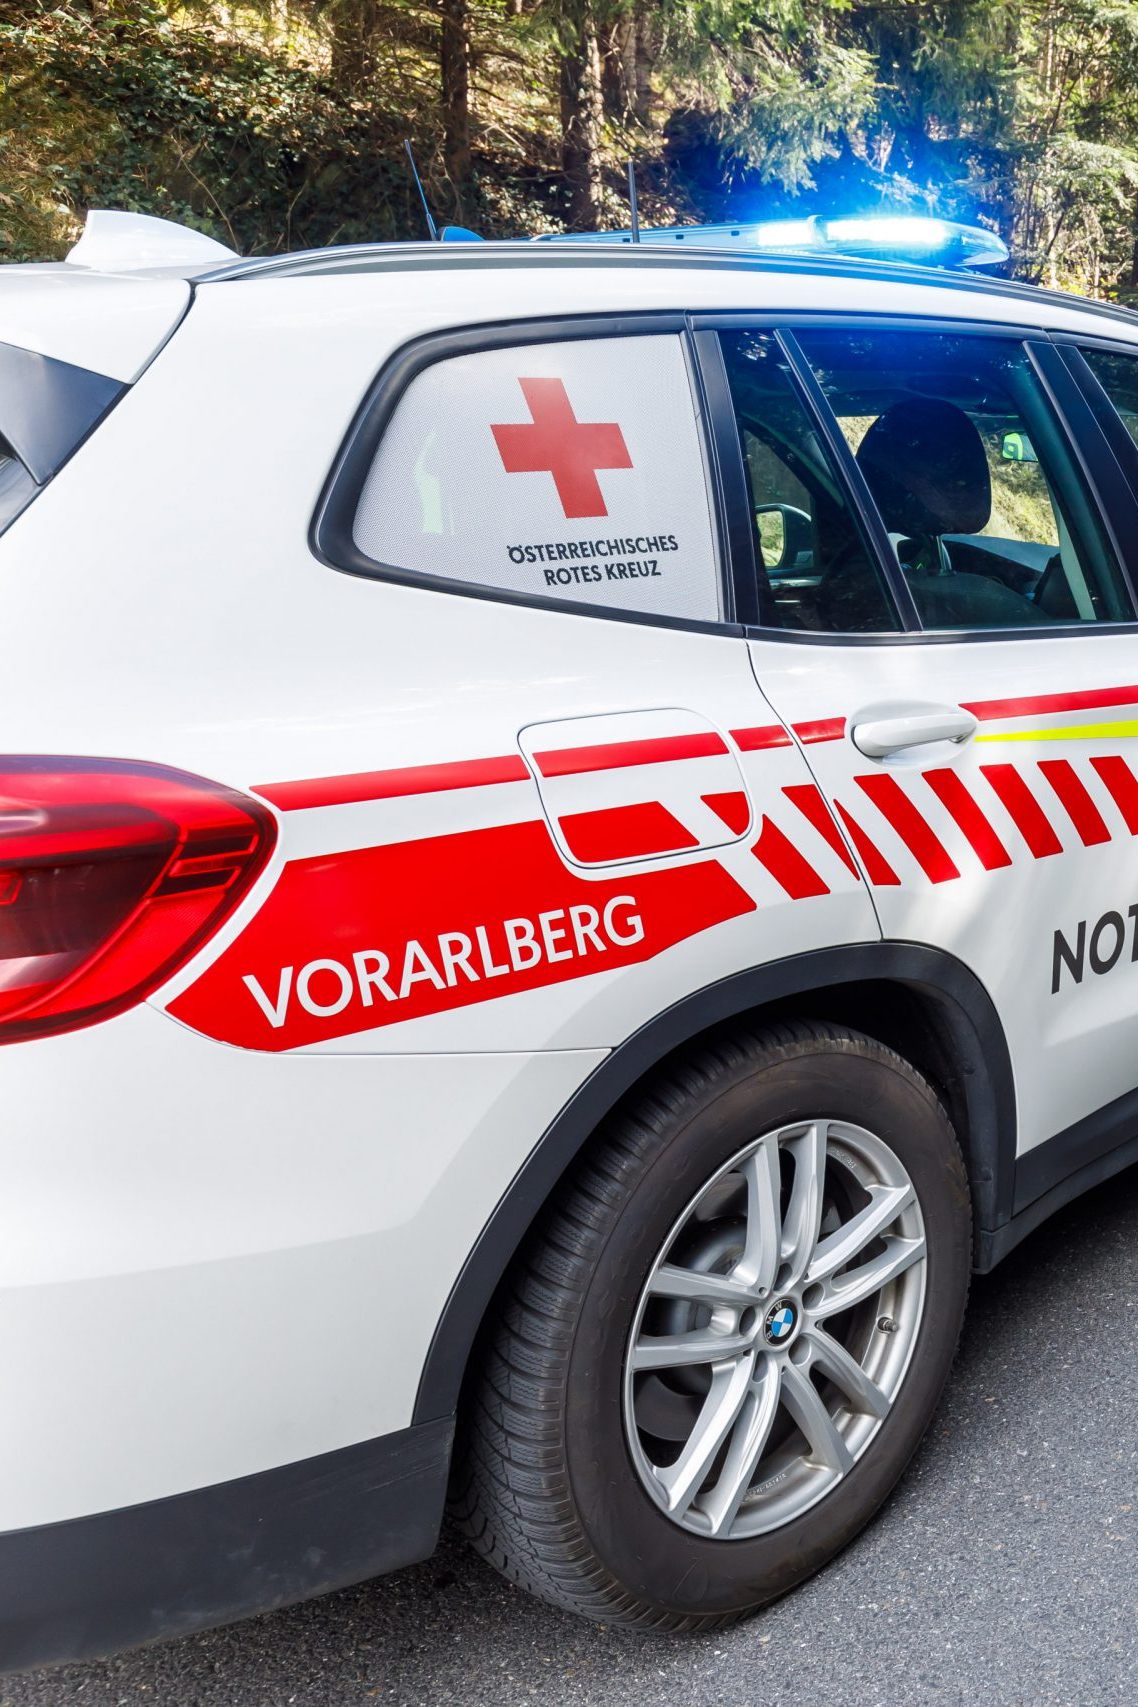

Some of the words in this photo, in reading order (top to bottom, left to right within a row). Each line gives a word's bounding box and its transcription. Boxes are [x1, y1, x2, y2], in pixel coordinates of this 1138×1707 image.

[507, 535, 679, 564] ÖSTERREICHISCHES
[543, 565, 602, 586] ROTES
[605, 560, 661, 580] KREUZ
[242, 895, 645, 1029] VORARLBERG
